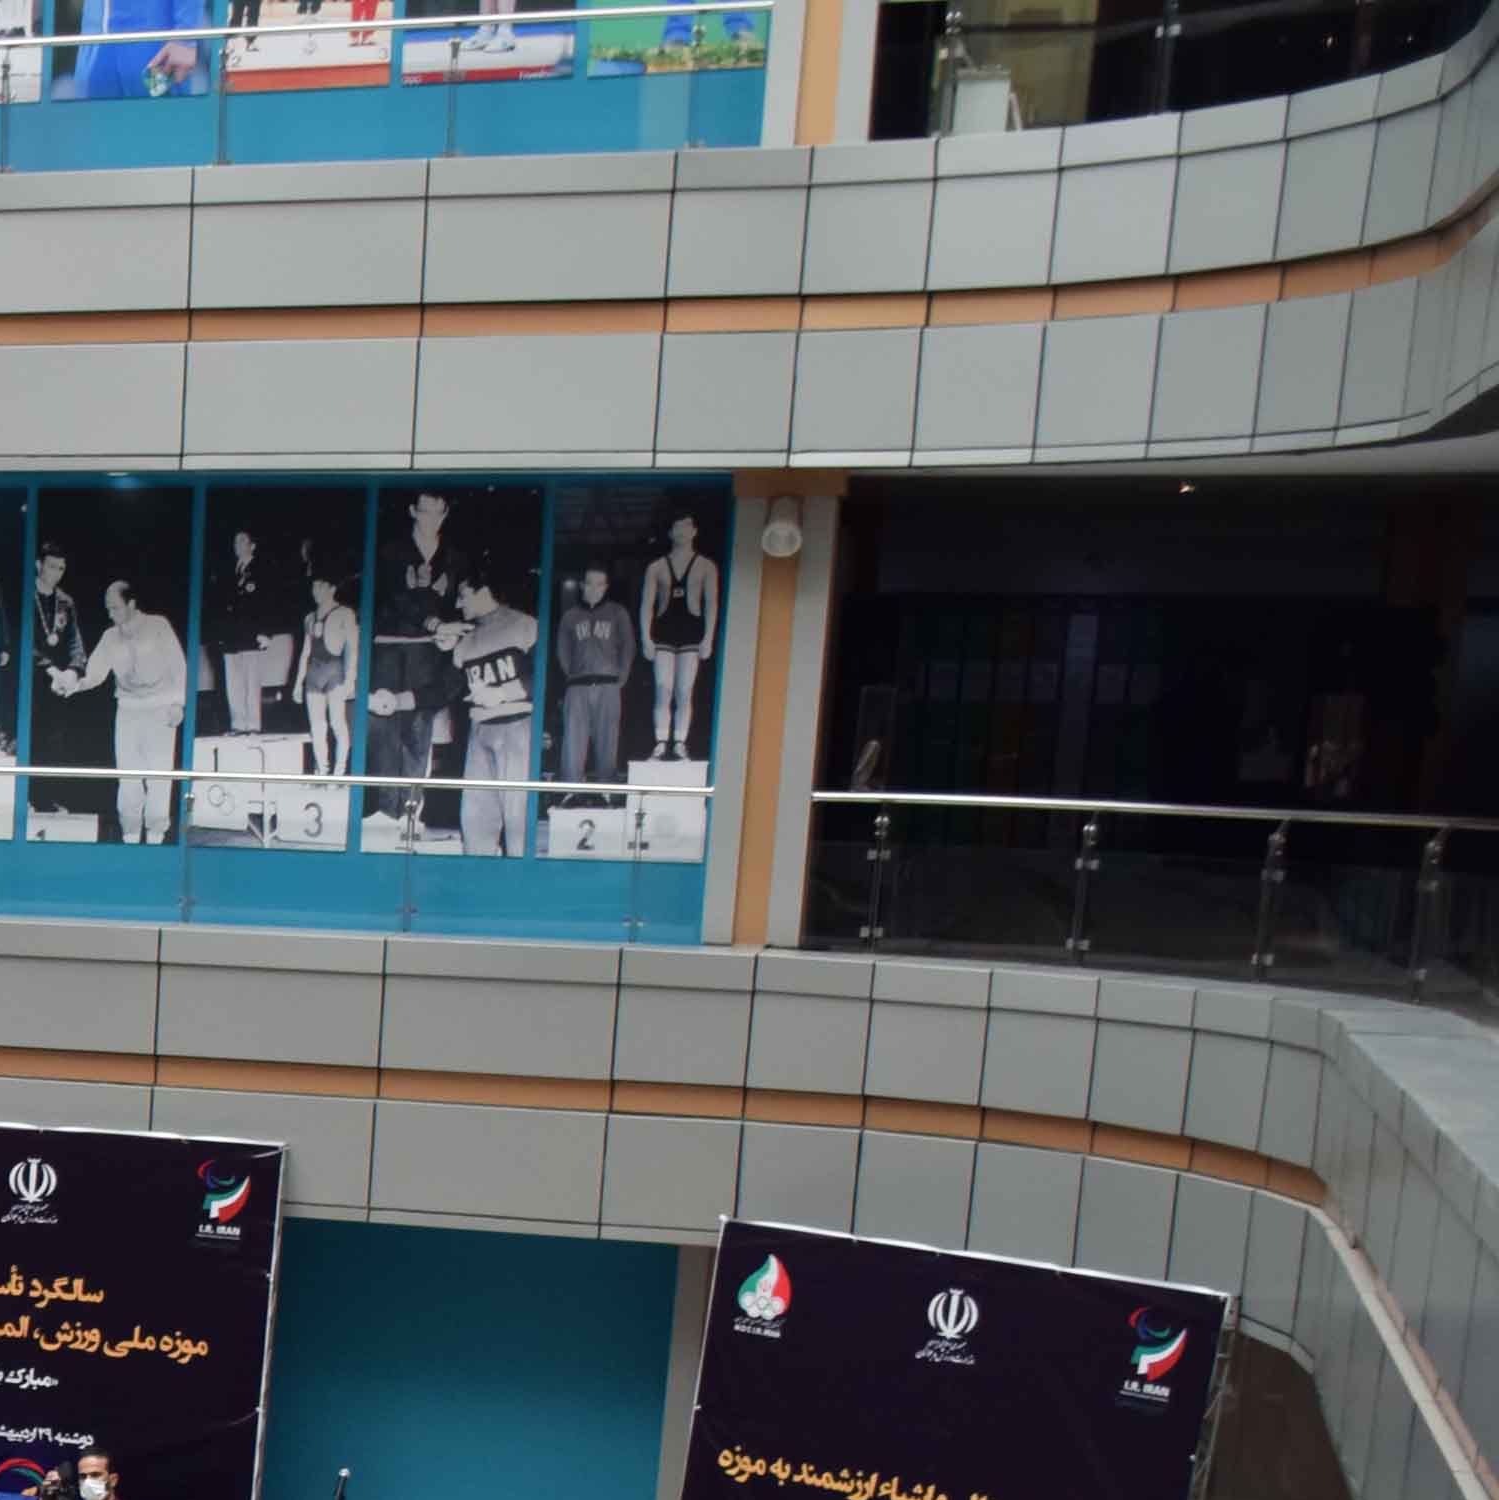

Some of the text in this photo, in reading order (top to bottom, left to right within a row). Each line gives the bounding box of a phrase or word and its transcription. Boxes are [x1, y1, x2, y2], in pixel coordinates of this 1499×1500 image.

[575, 619, 613, 642] IRAN
[465, 655, 516, 687] IRAN
[303, 802, 323, 838] 3
[576, 819, 595, 851] 2
[30, 1276, 104, 1308] سالگرد
[103, 1325, 157, 1358] ملی
[160, 1329, 208, 1364] موزه
[717, 1445, 766, 1483] موزه
[770, 1457, 791, 1486] به
